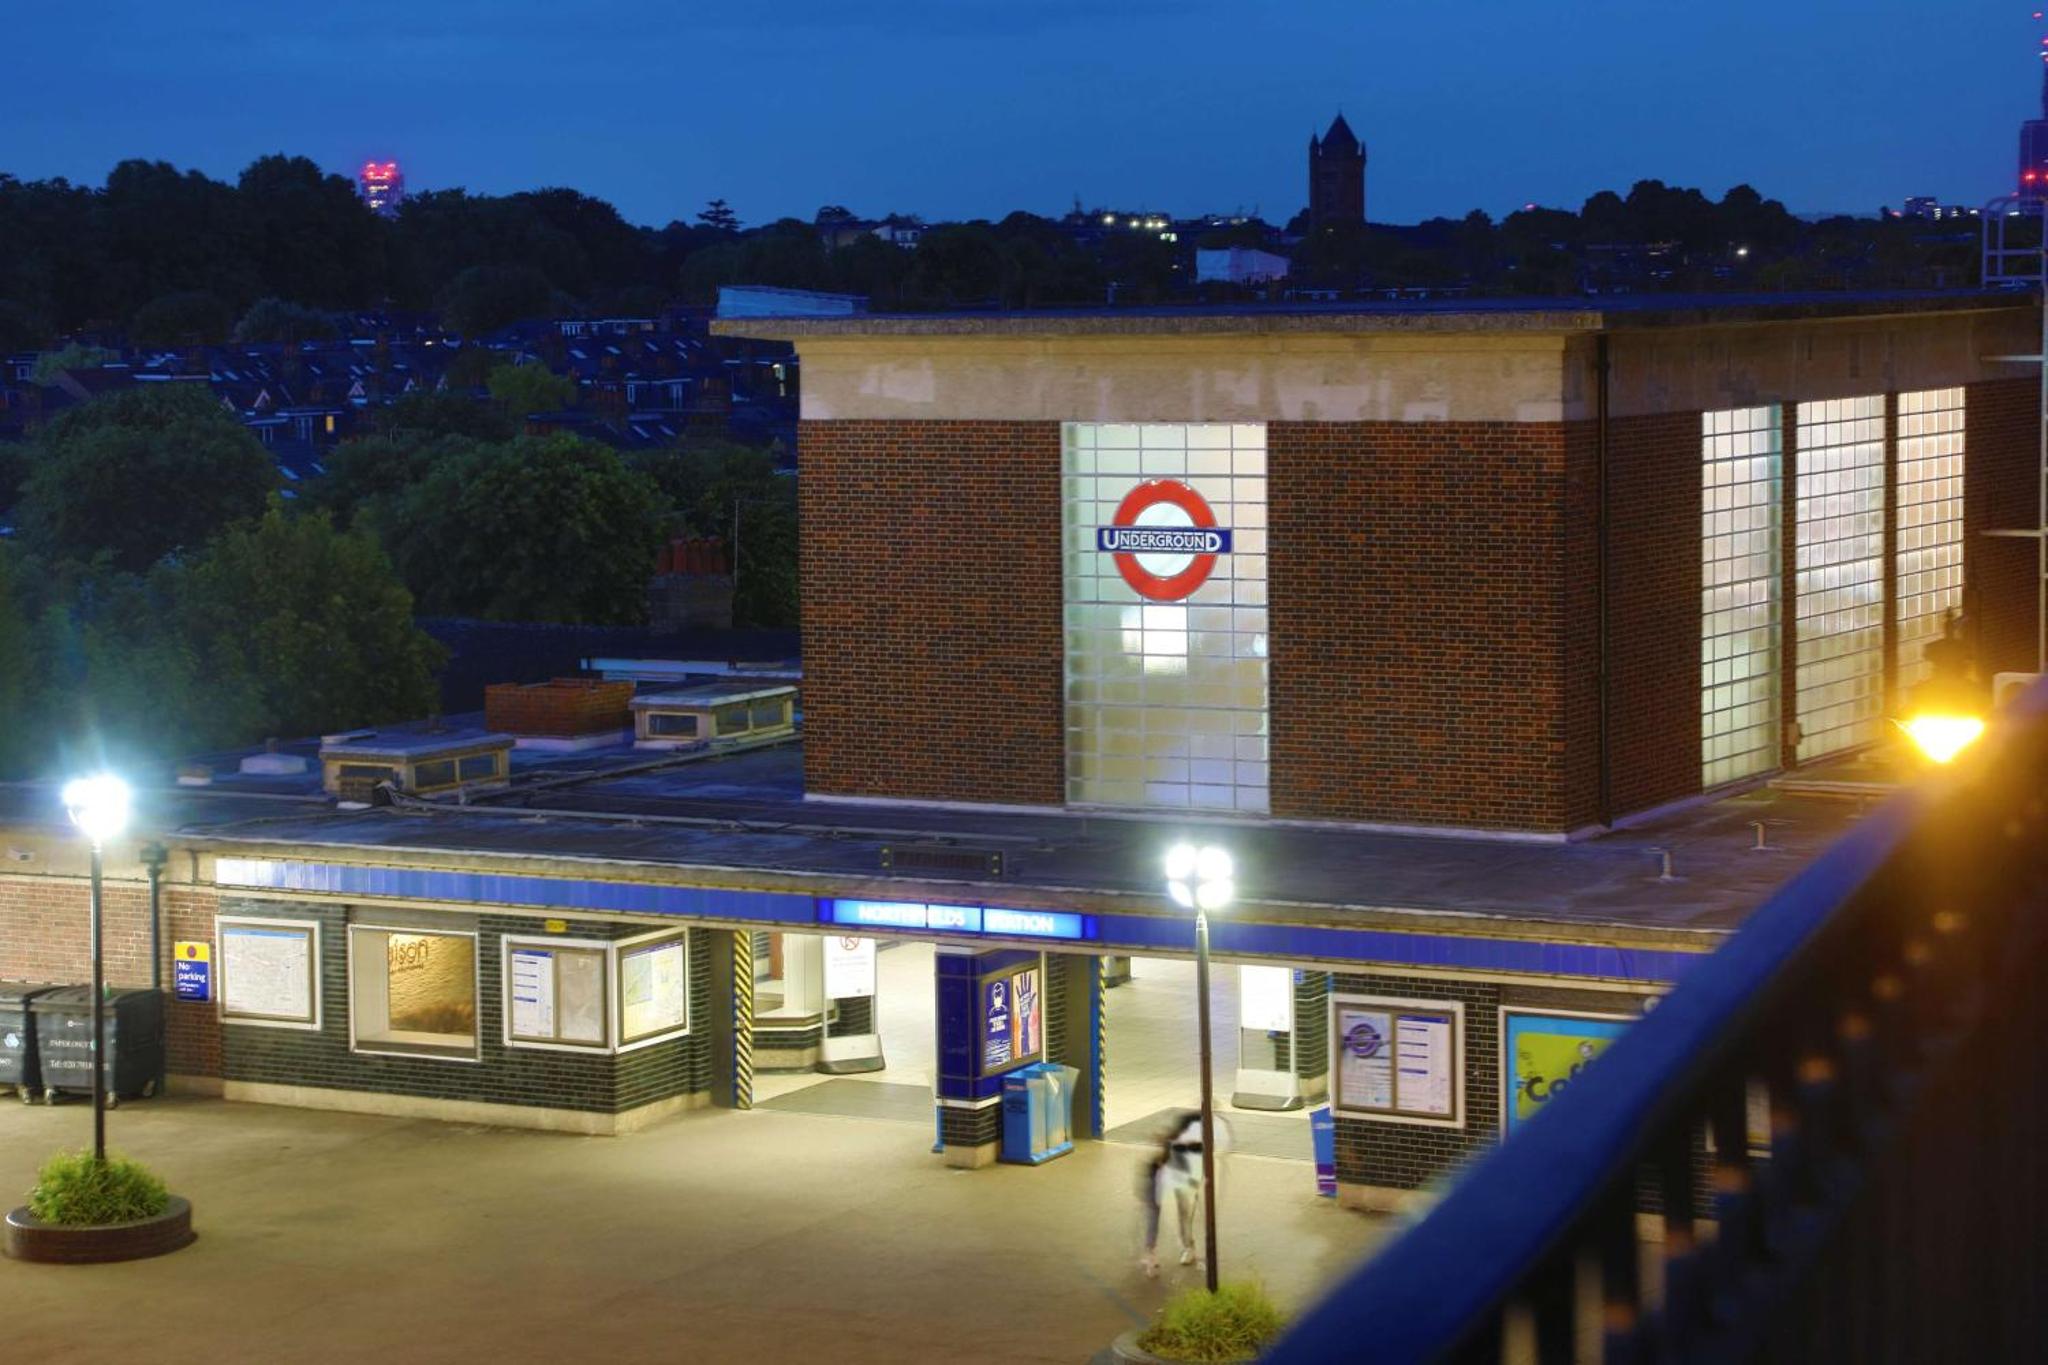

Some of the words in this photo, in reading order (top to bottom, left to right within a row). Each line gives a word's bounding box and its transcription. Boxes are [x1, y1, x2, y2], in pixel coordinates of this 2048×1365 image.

[1102, 529, 1222, 552] UNDERGROUND
[178, 962, 191, 970] No
[178, 972, 206, 983] parking
